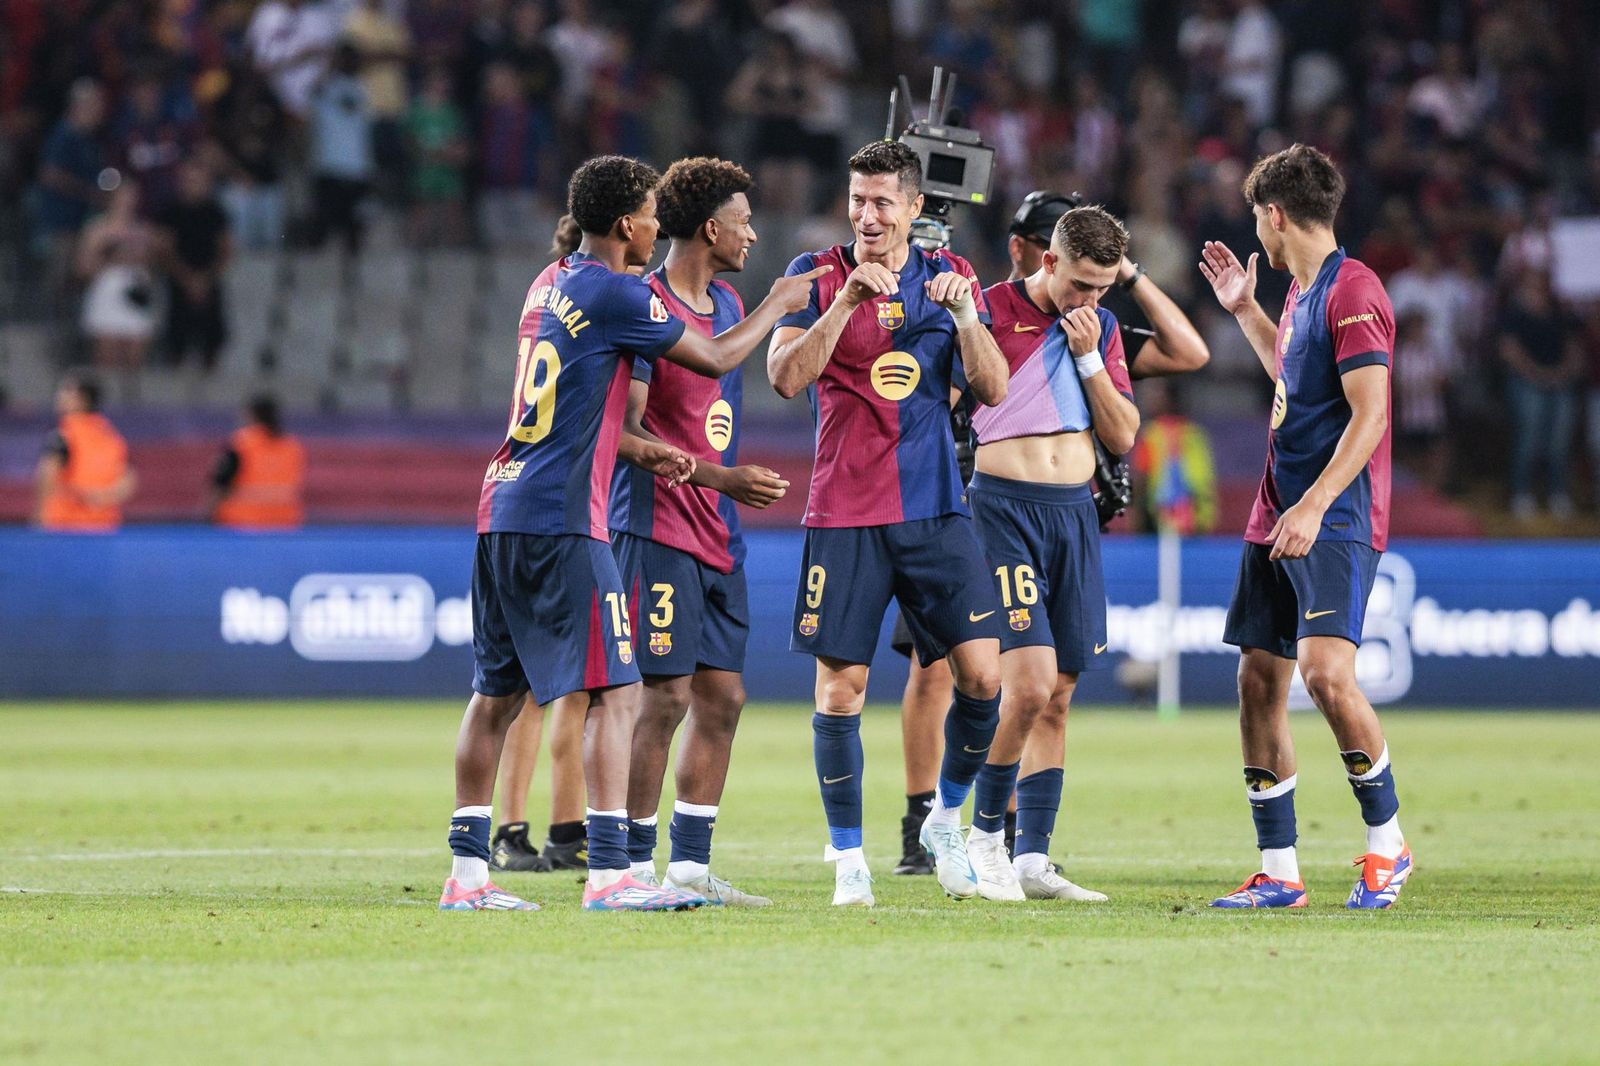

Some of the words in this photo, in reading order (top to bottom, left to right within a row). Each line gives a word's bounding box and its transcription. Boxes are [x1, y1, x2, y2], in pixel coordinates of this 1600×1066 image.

[1338, 313, 1375, 327] AMBILIGHT
[505, 337, 562, 444] 19
[649, 583, 675, 628] 3
[806, 564, 827, 609] 9
[994, 564, 1038, 608] 16
[605, 592, 631, 637] 19
